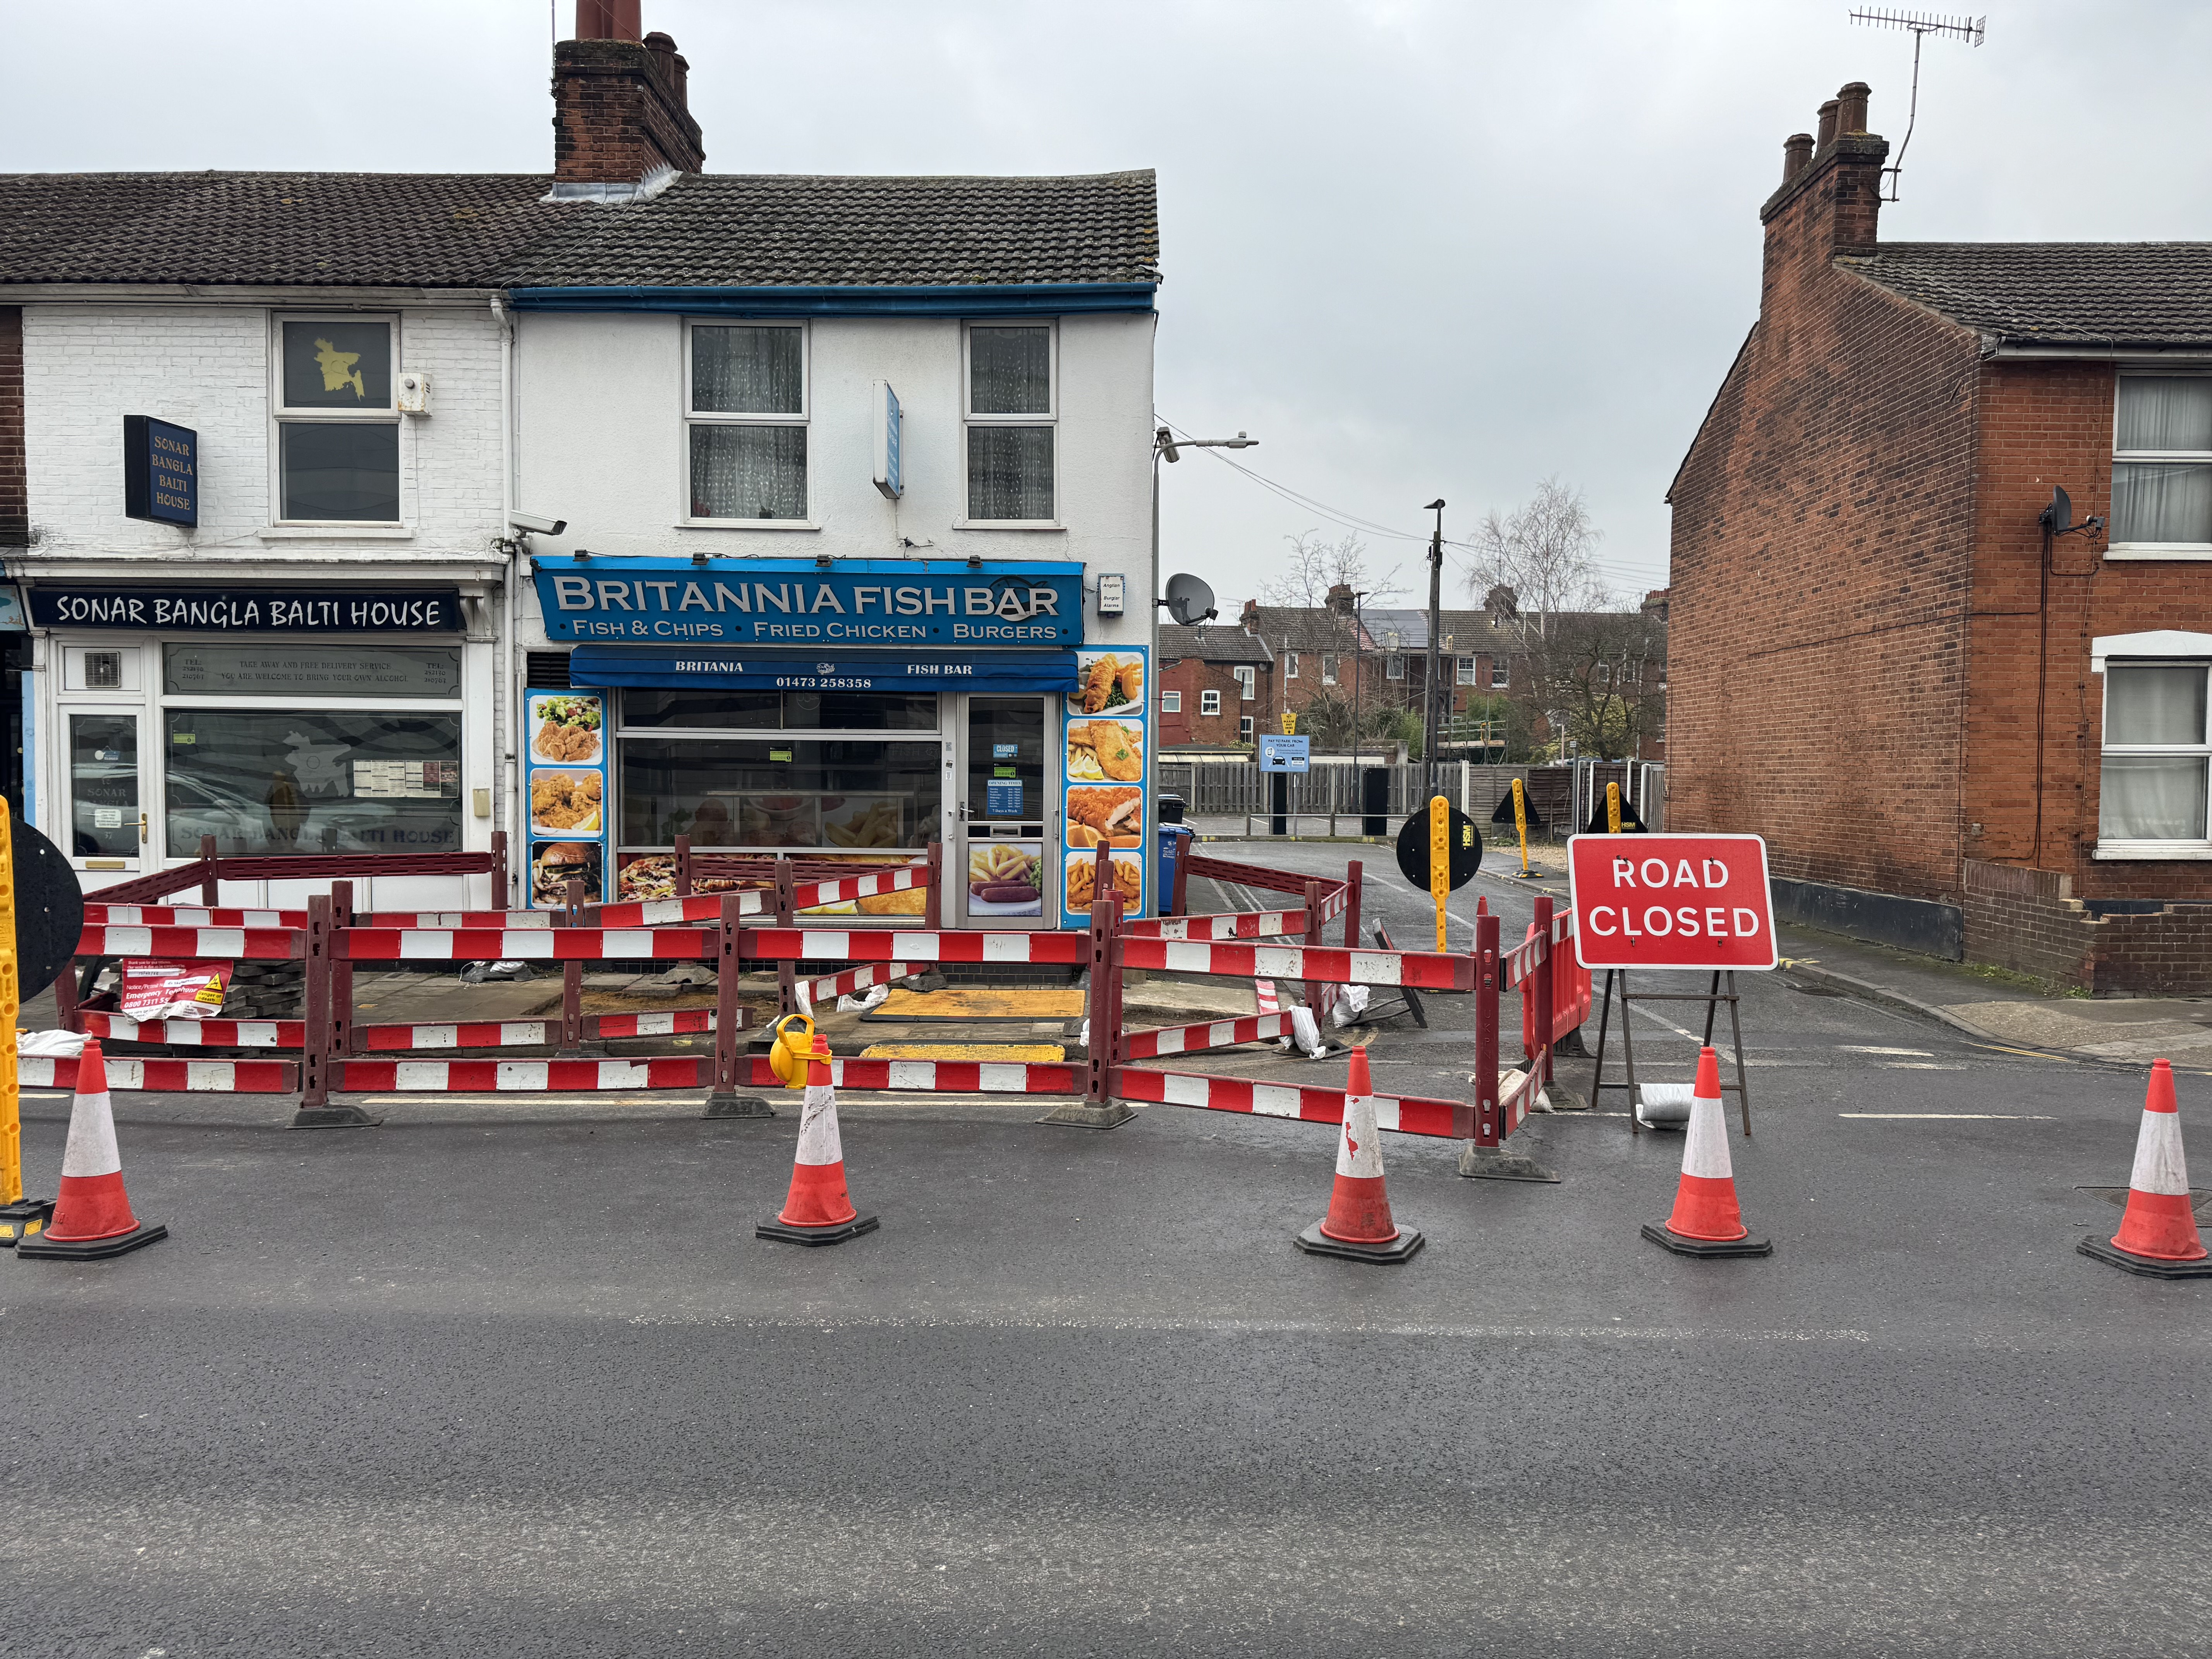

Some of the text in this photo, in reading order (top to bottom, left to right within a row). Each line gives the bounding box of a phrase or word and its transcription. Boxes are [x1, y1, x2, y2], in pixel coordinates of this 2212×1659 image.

[155, 436, 189, 456] SONAR
[152, 454, 193, 475] BANGLA
[159, 475, 187, 492] BALTI
[156, 492, 190, 510] HOUSE
[551, 576, 1060, 616] BRITANNIA FISH BAR
[57, 596, 440, 628] SONAR BANGLA BALTI HOUSE
[572, 620, 723, 636] FISH & CHIPS
[754, 622, 926, 638] FRIED CHICKEN
[953, 623, 1056, 639] BURGERS
[675, 661, 743, 672] BRITANIA
[907, 665, 972, 675] FISH BAR
[776, 677, 871, 688] 01473 258358
[88, 788, 126, 797] SONAR
[393, 830, 454, 843] HOUSE
[1463, 825, 1471, 846] HSM
[1613, 859, 1729, 888] ROAD
[1589, 906, 1759, 937] CLOSED
[126, 990, 162, 999] Emergency
